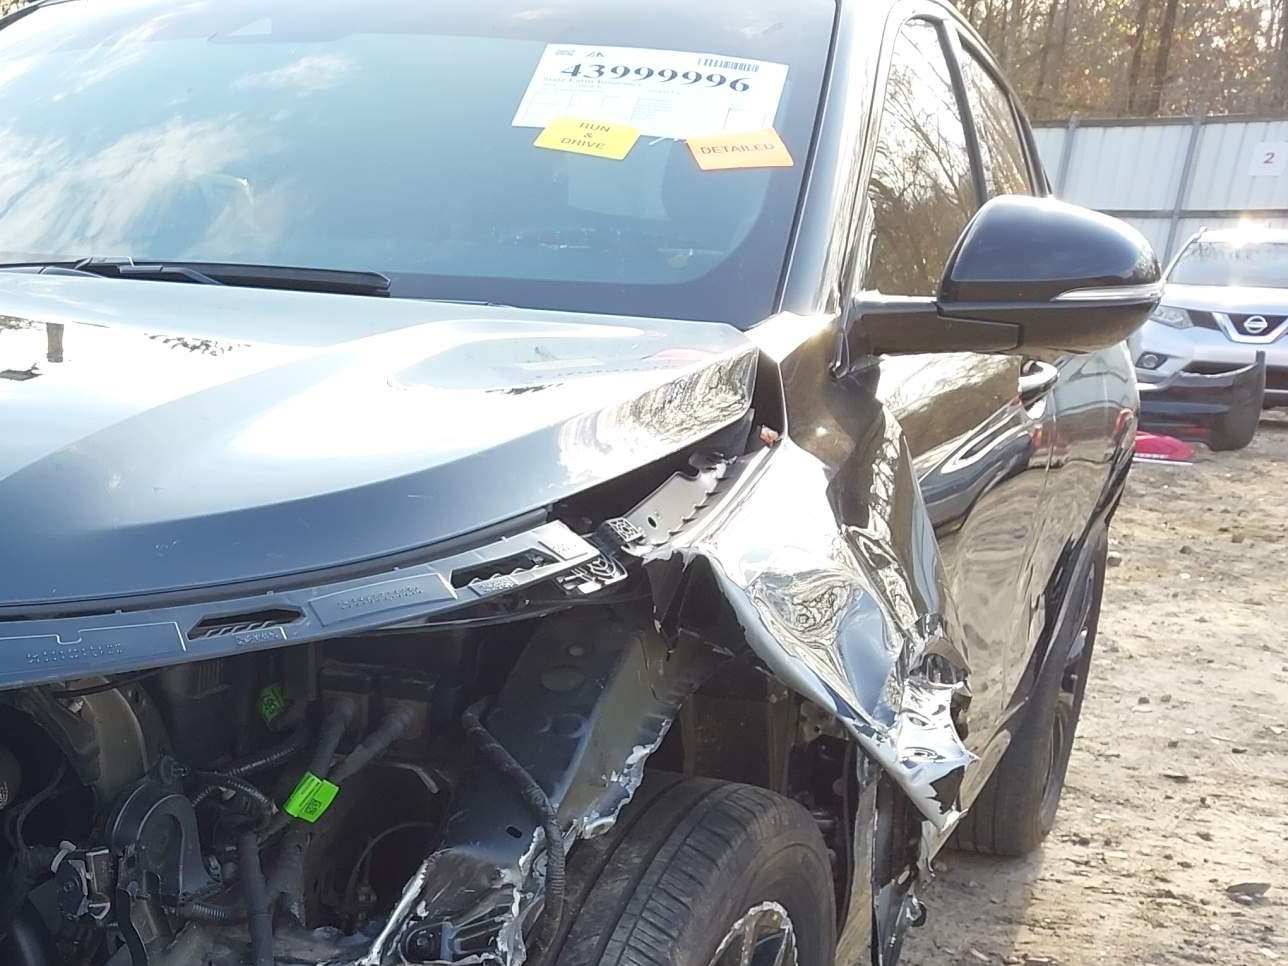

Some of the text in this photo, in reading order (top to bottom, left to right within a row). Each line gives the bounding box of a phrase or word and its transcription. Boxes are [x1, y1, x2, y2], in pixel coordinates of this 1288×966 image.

[560, 63, 752, 92] 43999996
[579, 122, 611, 133] RUN
[560, 137, 607, 150] DRIVE
[700, 143, 776, 155] DETAILED
[1264, 152, 1275, 164] 2
